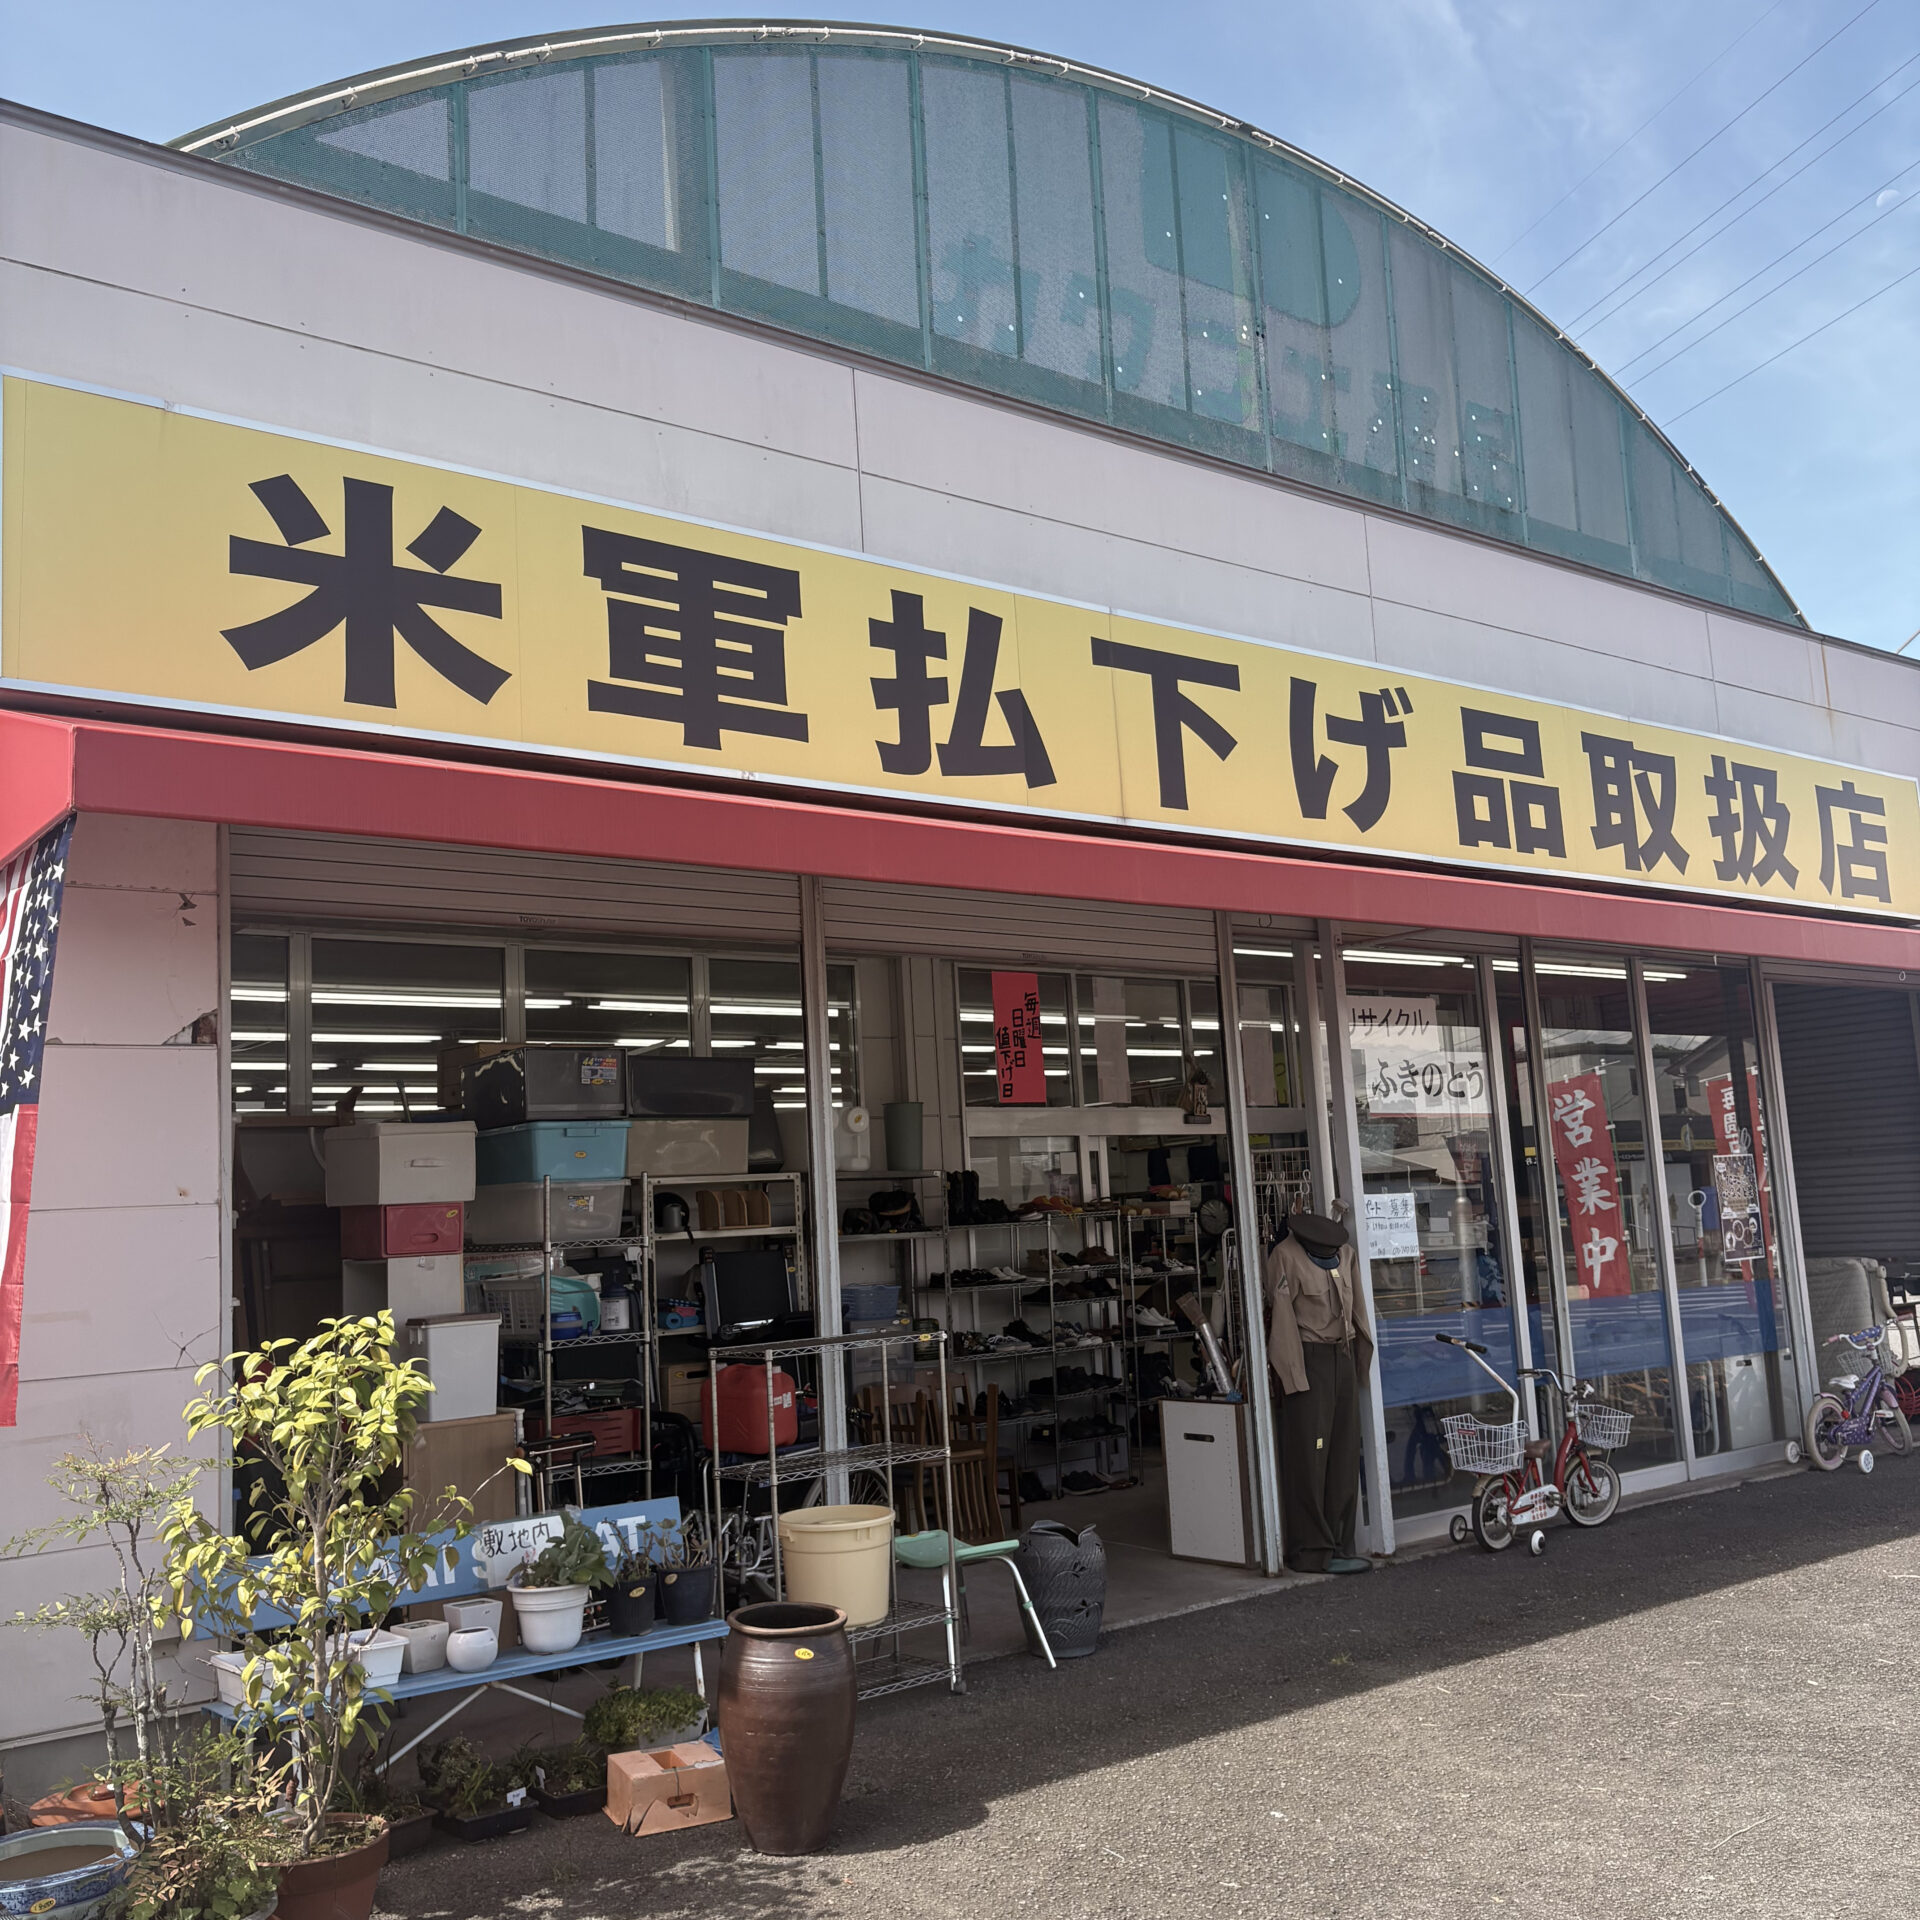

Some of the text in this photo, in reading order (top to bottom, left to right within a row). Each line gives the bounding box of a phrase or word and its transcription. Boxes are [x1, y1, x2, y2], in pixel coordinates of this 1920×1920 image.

[220, 474, 1892, 904] 米軍払下げ品取扱店
[1012, 1008, 1027, 1068] 日曜日
[1024, 991, 1042, 1039] 毎週
[995, 1026, 1015, 1098] 値下げ日
[1372, 1058, 1484, 1100] ふきのとう
[1552, 1088, 1619, 1289] 営業中
[483, 1521, 550, 1558] 敷地内
